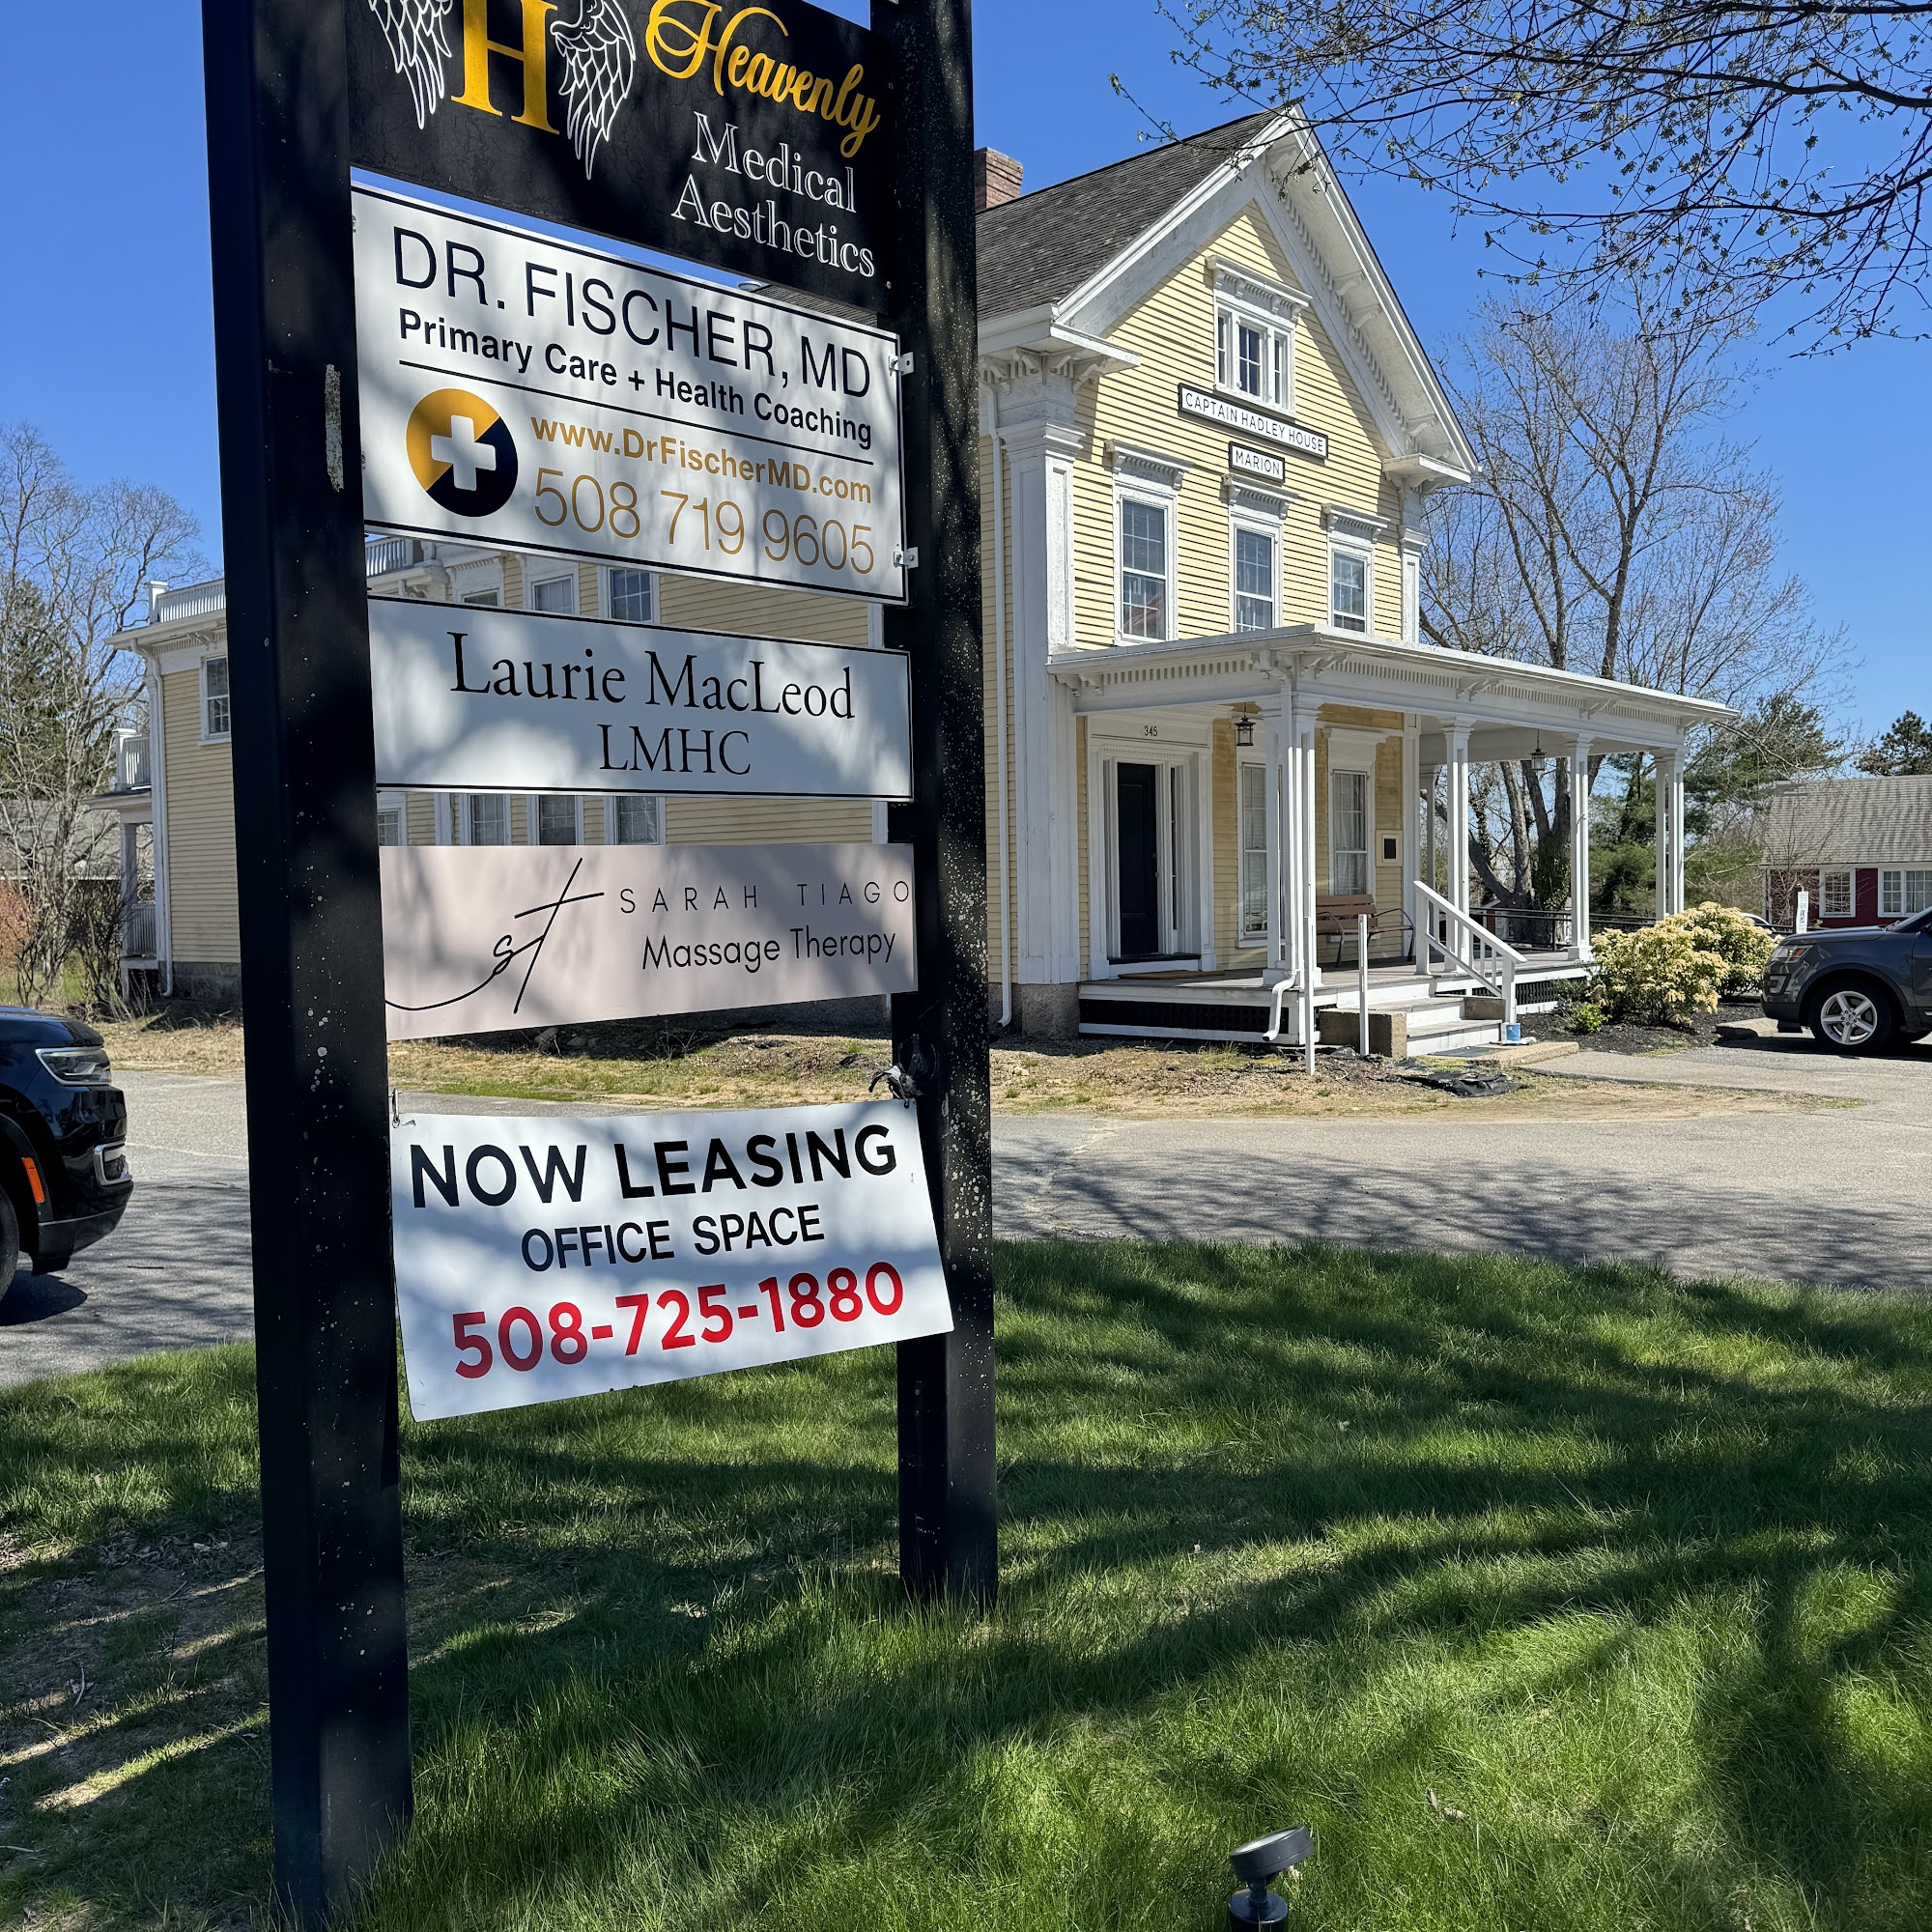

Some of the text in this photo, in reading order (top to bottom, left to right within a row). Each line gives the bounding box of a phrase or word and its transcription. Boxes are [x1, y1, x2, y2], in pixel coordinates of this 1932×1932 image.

[645, 0, 881, 158] Heavenly
[692, 111, 858, 213] Medical
[671, 174, 876, 279] Aesthetics
[393, 225, 871, 399] DR. FISCHER, MD
[399, 308, 532, 375] Primary
[544, 343, 617, 386] Care
[656, 366, 745, 416] Health
[753, 397, 872, 450] Coaching
[1185, 392, 1323, 453] CAPTAIN HADLEY HOUSE
[530, 415, 872, 505] www.DrFischerMD.com
[1235, 449, 1281, 476] MARION
[534, 467, 875, 575] 508 719 9605
[446, 631, 856, 720] Laurie MacLeod
[596, 724, 752, 776] LMHC
[1144, 724, 1158, 737] 345
[620, 880, 910, 915] SARAH TIAGO
[641, 925, 896, 973] Massage Therapy
[411, 1123, 898, 1208] NOW LEASING
[521, 1205, 825, 1272] OFFICE SPACE
[452, 1262, 904, 1379] 508-725-1880
